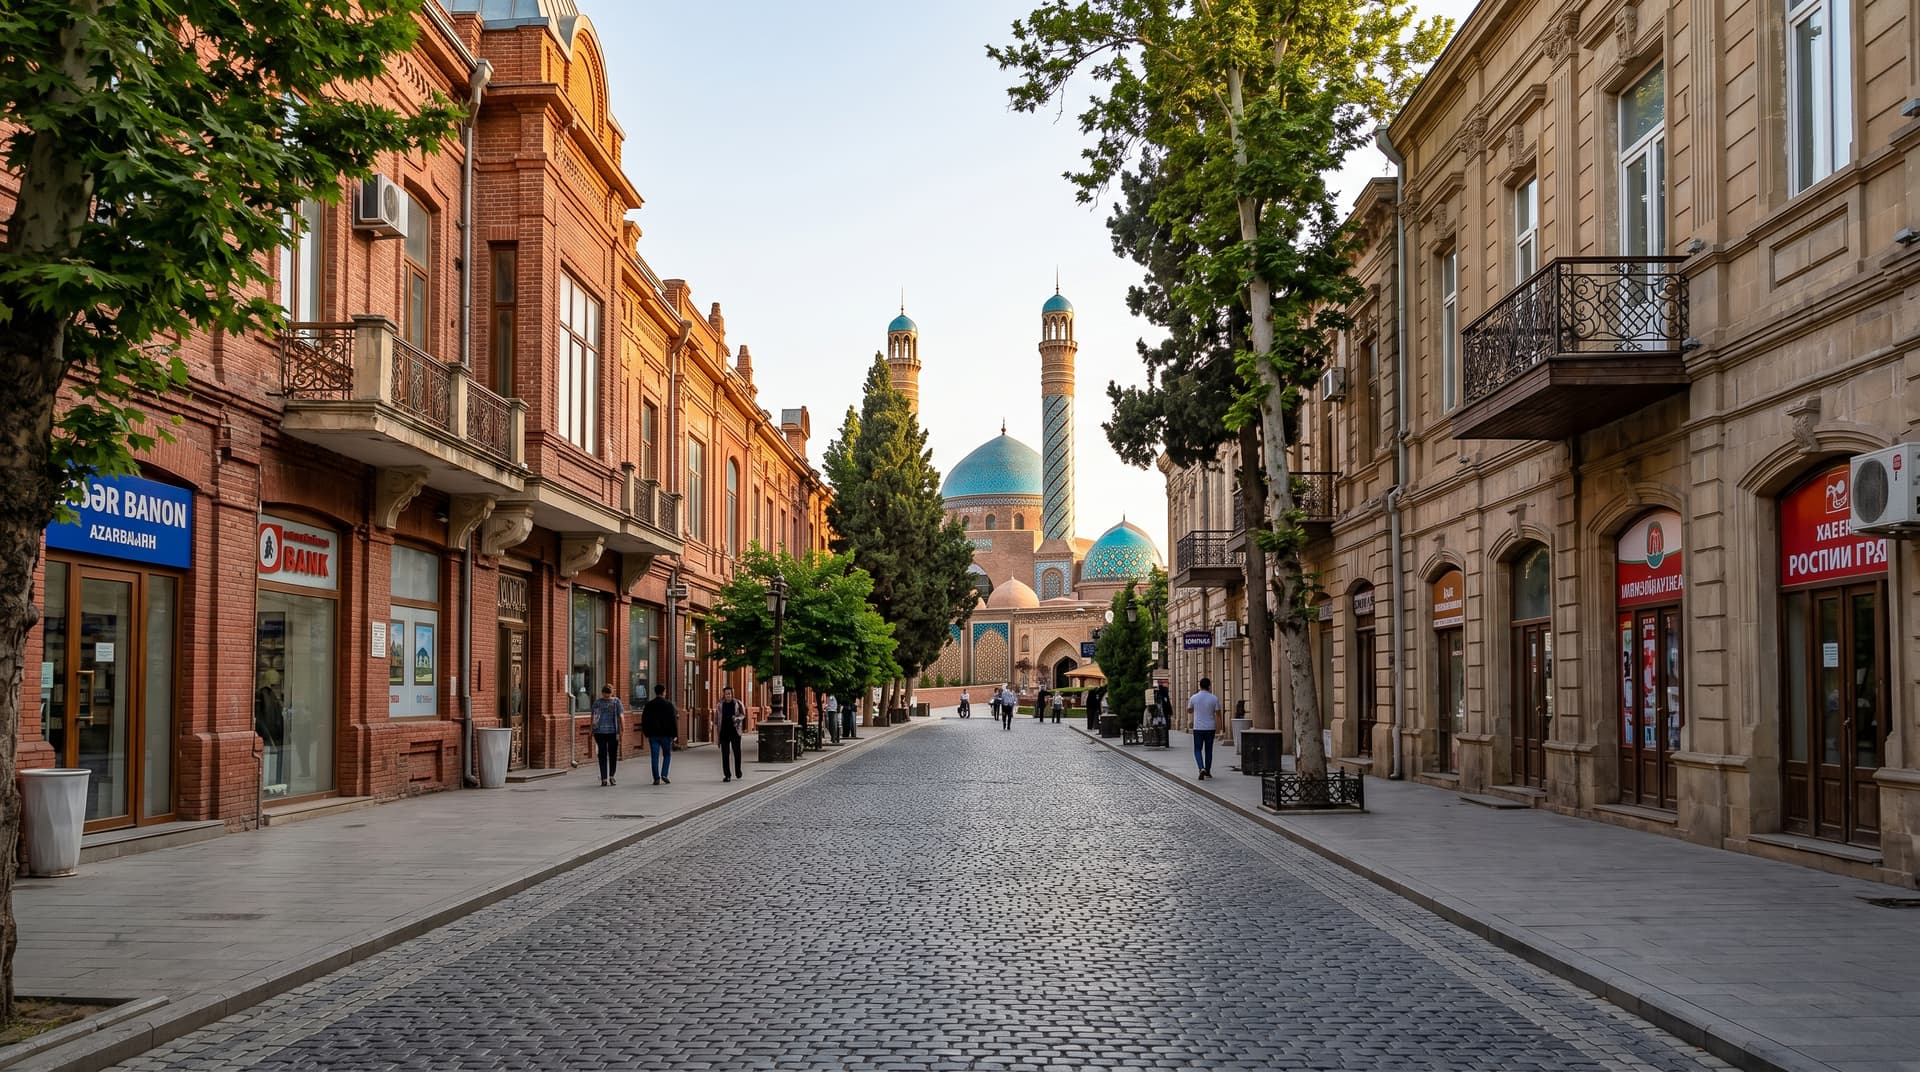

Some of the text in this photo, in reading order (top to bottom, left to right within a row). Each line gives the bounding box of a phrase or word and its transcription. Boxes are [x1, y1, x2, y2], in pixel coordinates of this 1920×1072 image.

[124, 490, 187, 529] BANON
[284, 545, 329, 578] BANK
[1789, 544, 1852, 577] РОСПИИ
